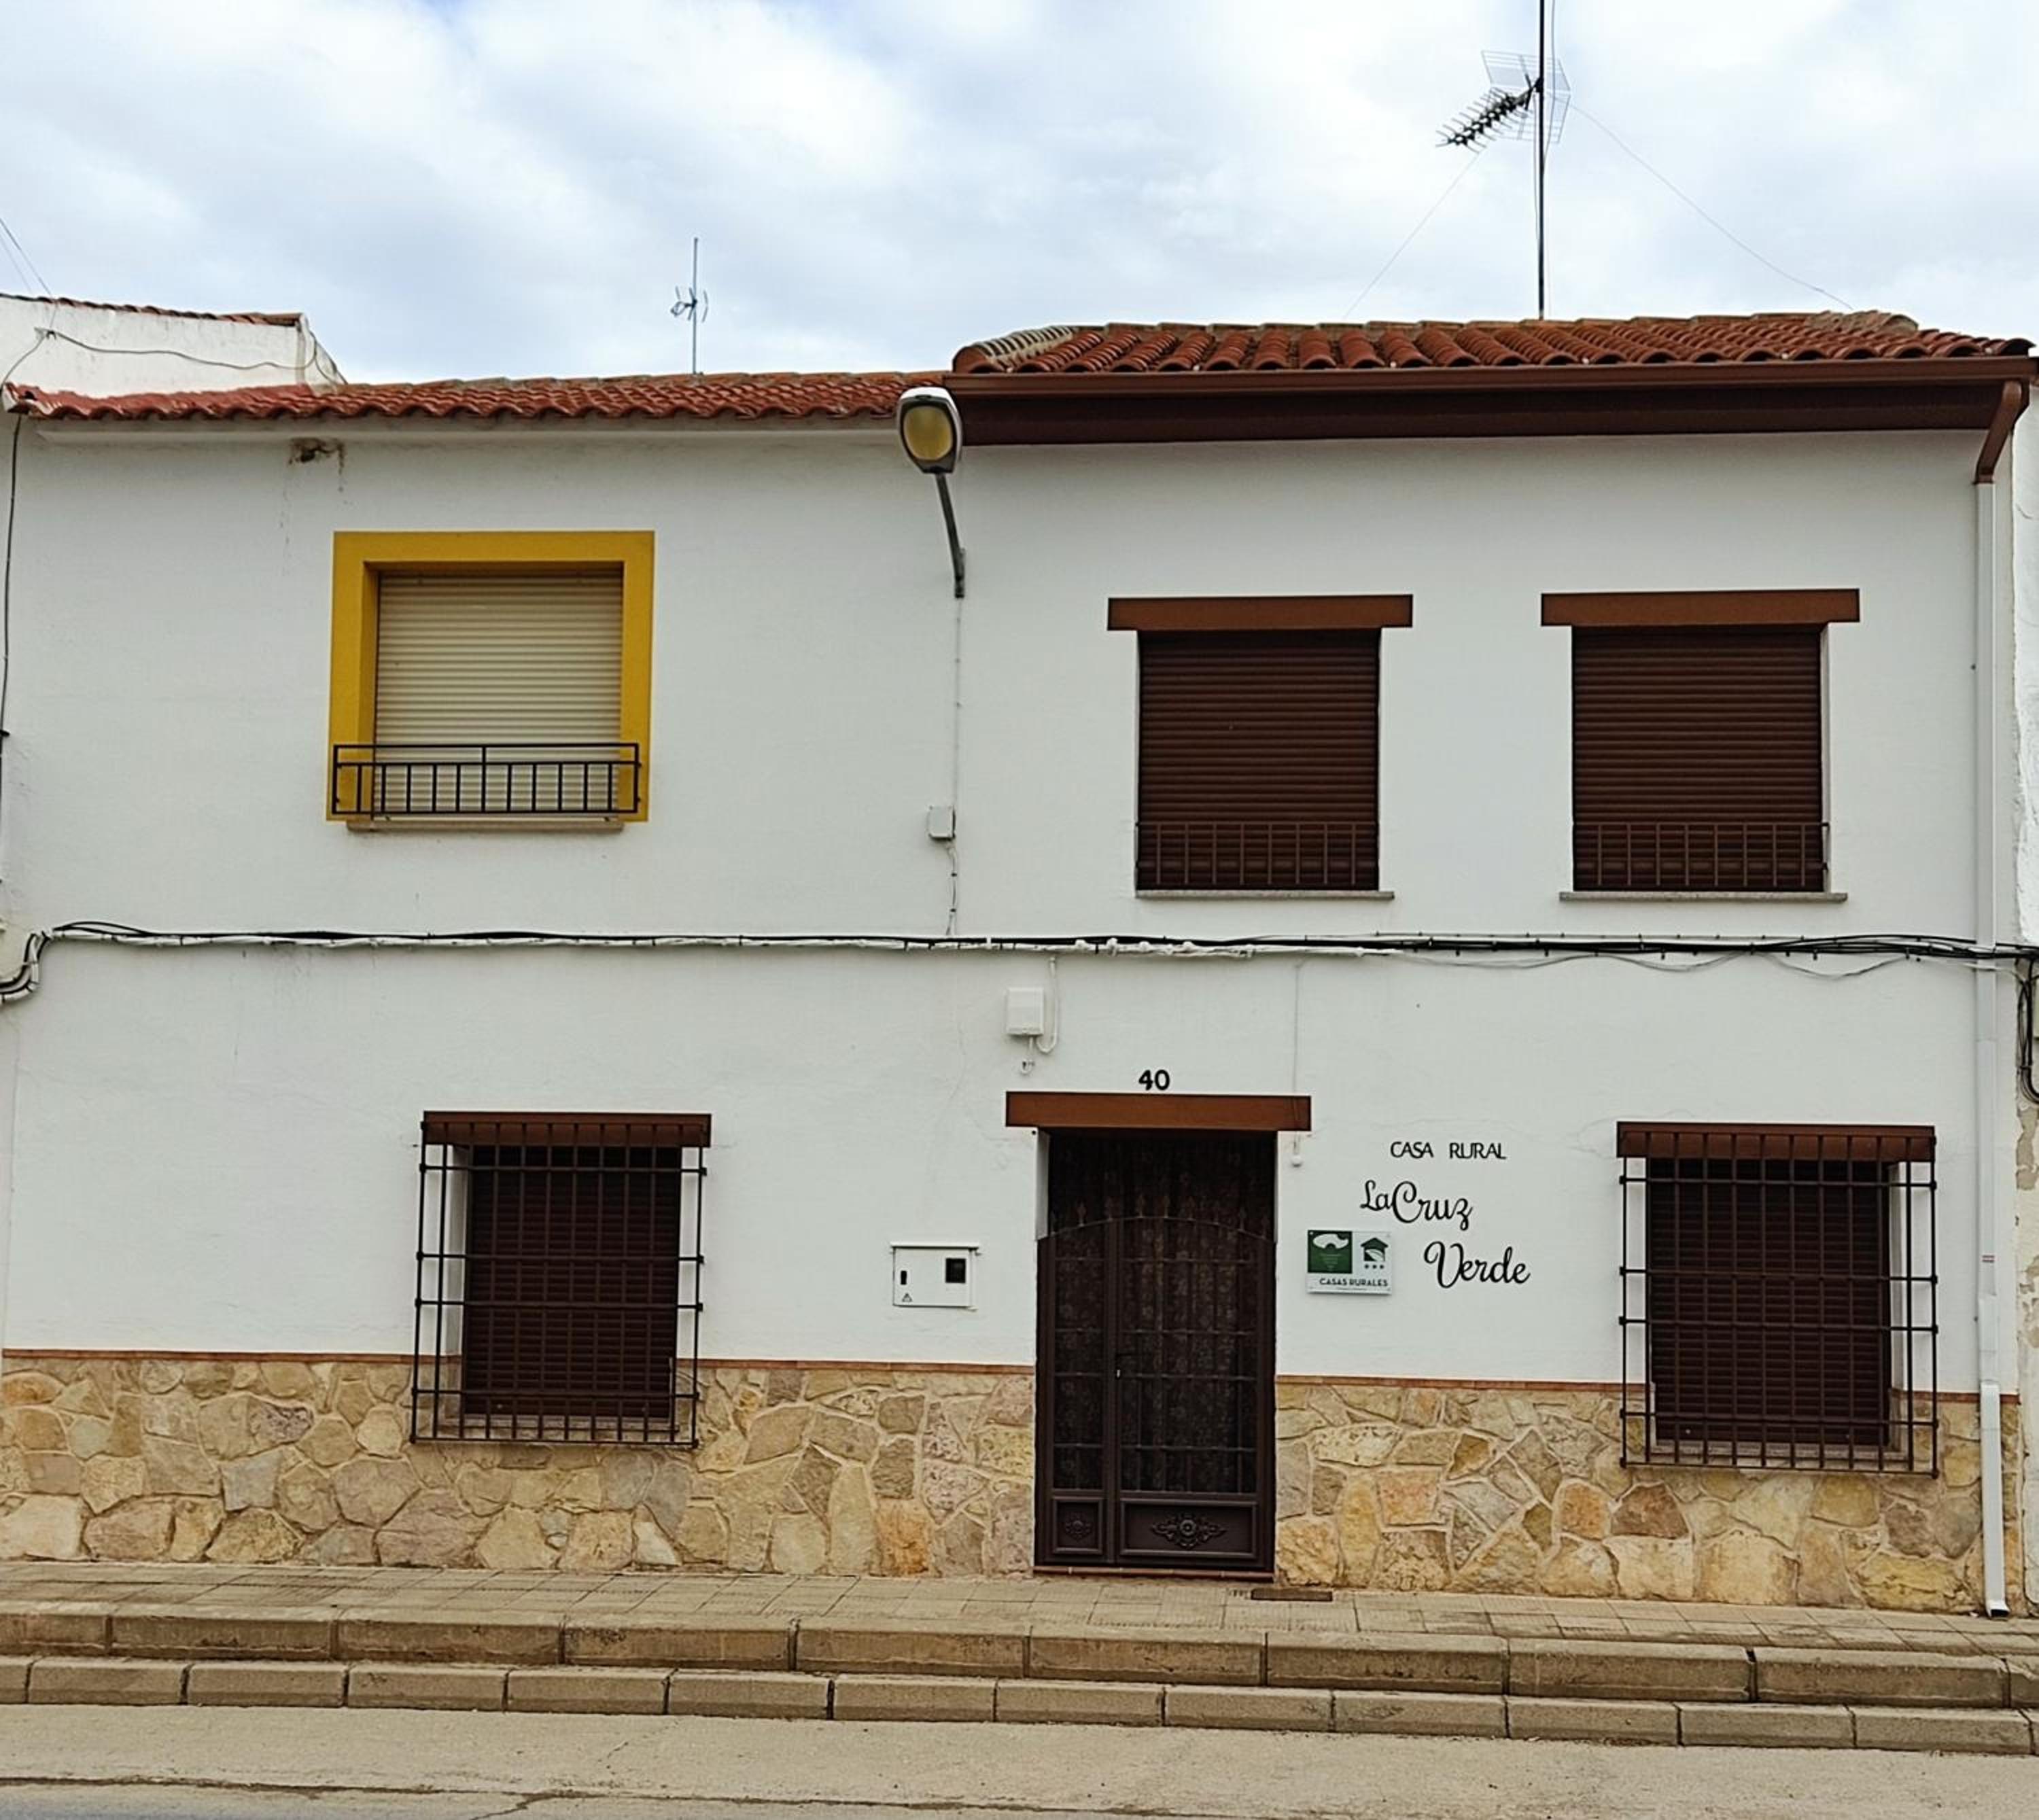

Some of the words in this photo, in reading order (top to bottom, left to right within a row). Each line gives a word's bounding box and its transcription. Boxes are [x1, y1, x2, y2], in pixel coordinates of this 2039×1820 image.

[1138, 1069, 1170, 1091] 40
[1390, 1141, 1434, 1159] CASA
[1449, 1142, 1507, 1160] RURAL
[1423, 1241, 1531, 1289] Verde
[1319, 1278, 1348, 1286] CASAS
[1349, 1278, 1389, 1287] RURALES
